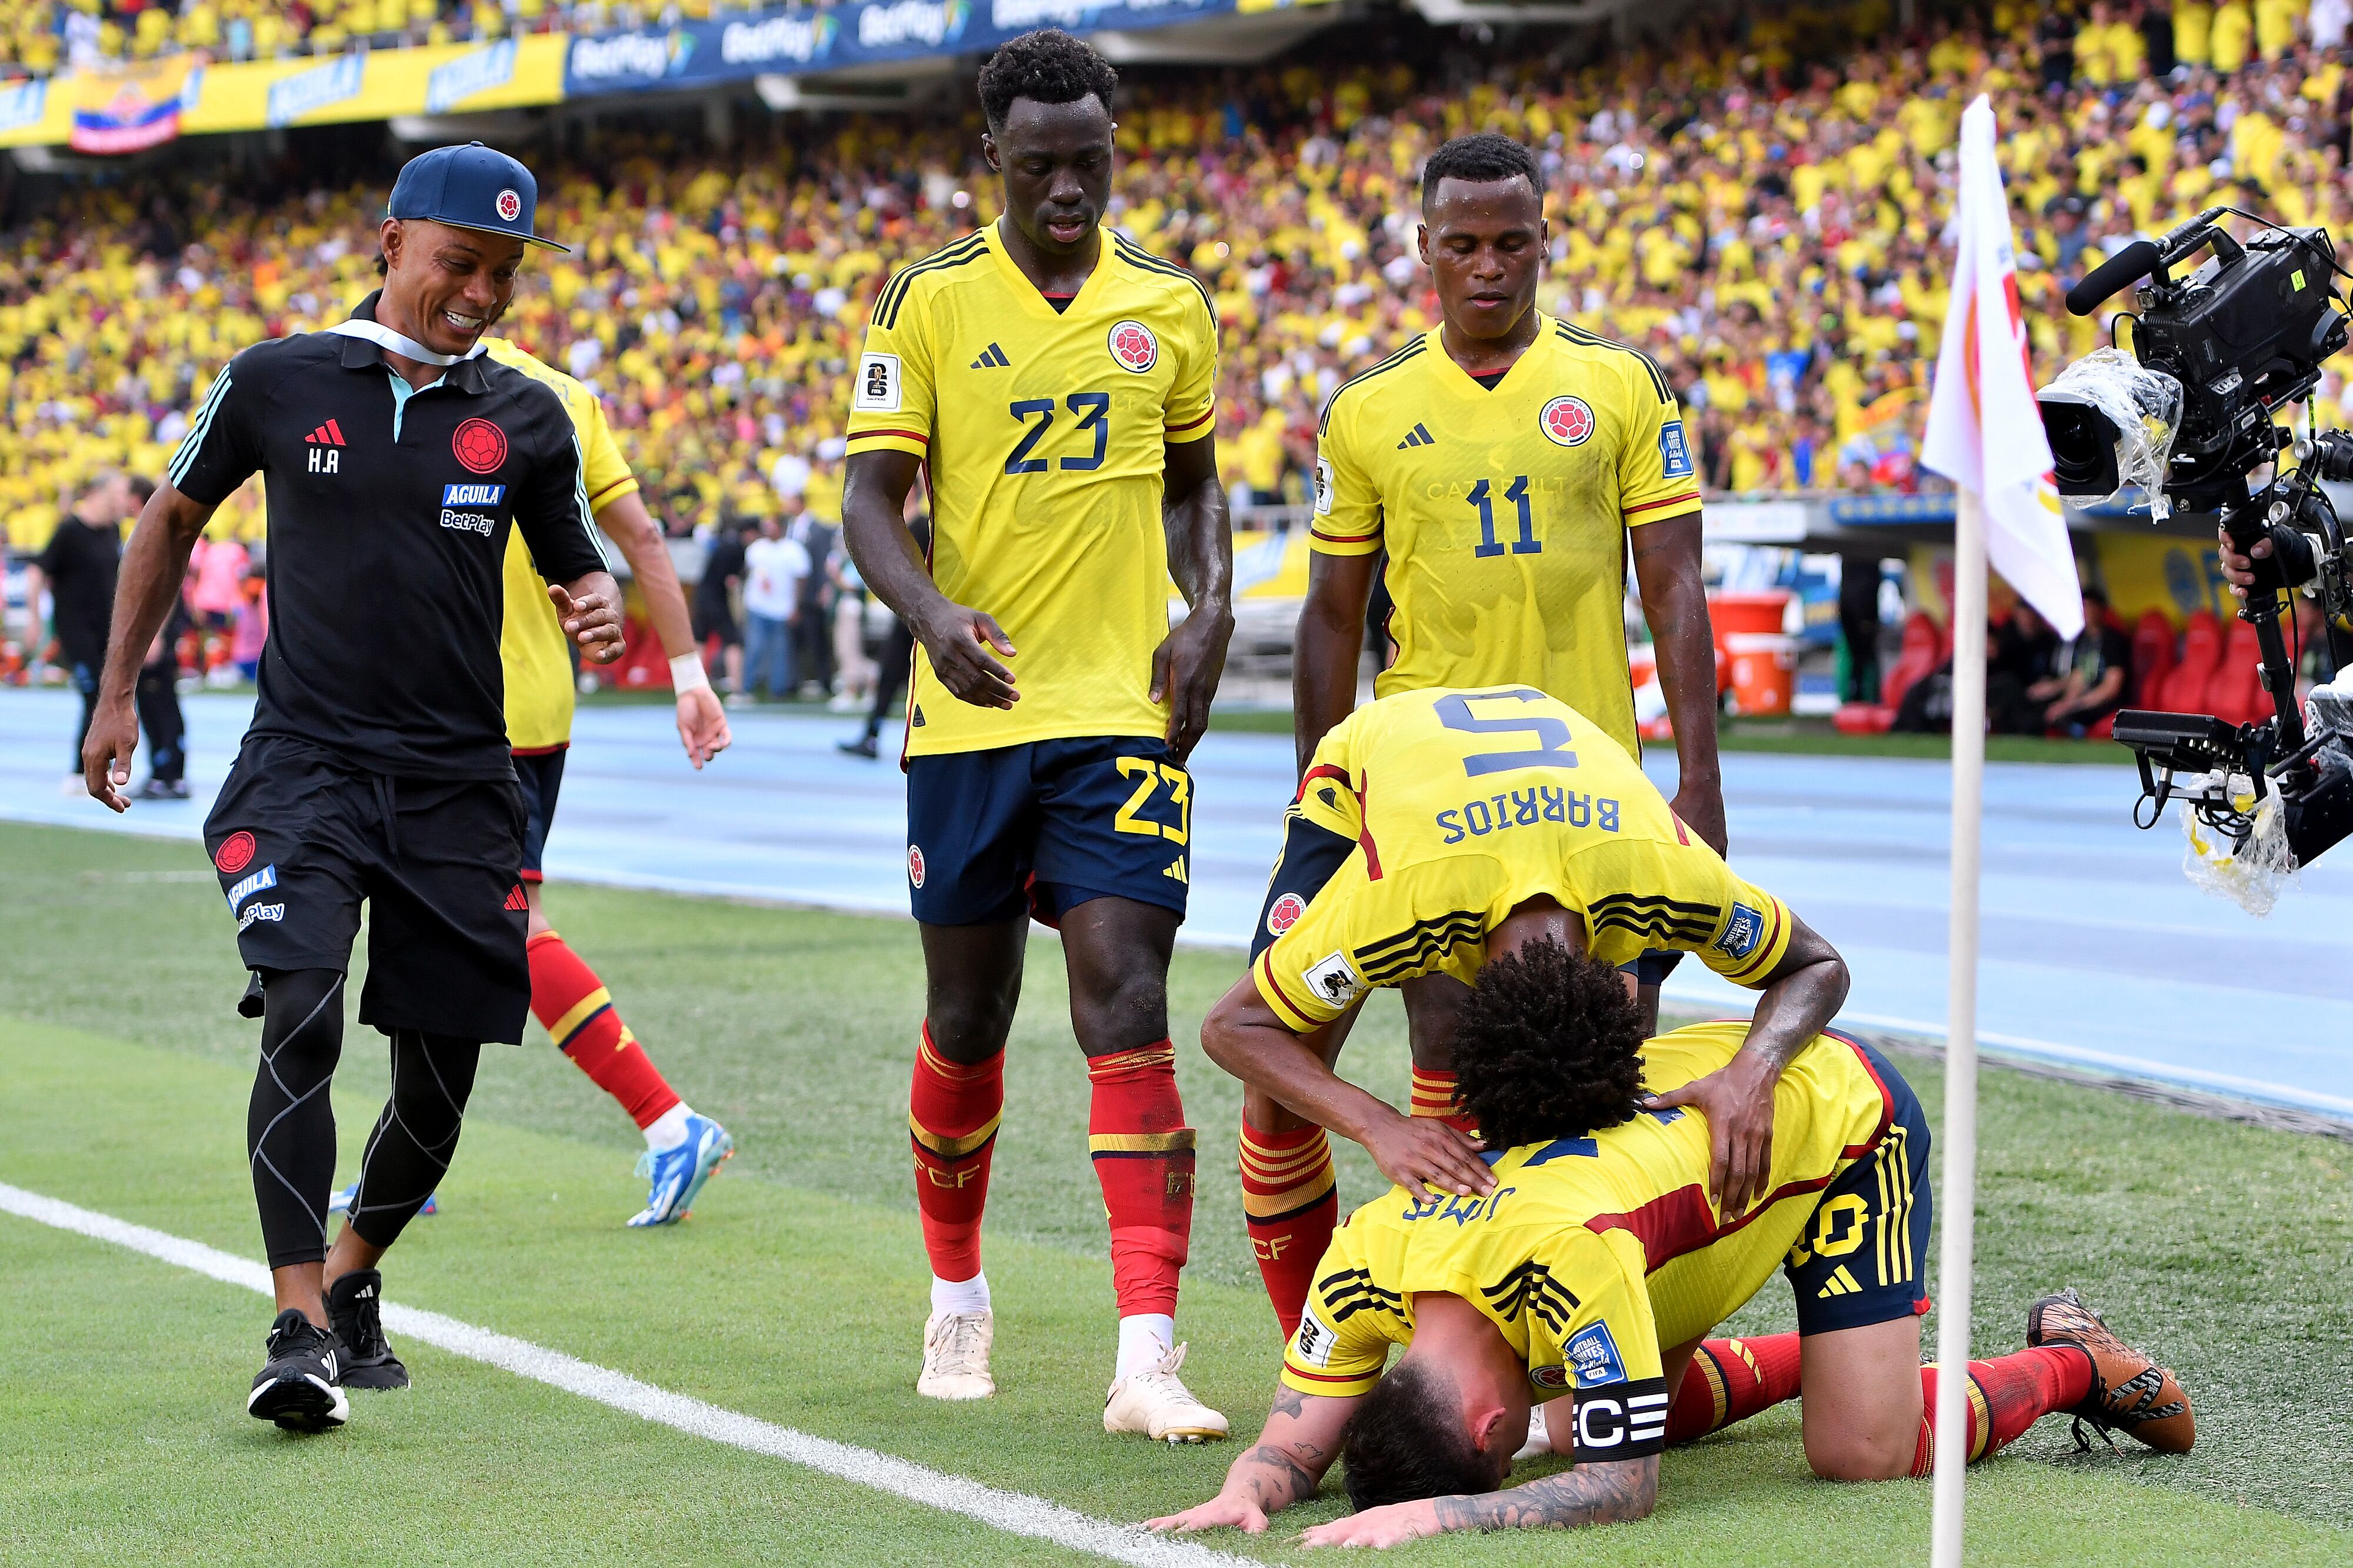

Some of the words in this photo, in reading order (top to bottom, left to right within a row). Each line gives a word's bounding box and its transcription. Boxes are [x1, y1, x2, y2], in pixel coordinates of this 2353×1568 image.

[1005, 392, 1110, 475] 23
[445, 485, 500, 505] AGUILA
[1466, 475, 1542, 558] 11
[440, 509, 495, 536] BetPlay
[1433, 689, 1579, 777] 5
[1115, 756, 1190, 846] 23
[1435, 786, 1619, 845] BARRIOS
[1572, 1335, 1601, 1356] OOTBALL
[1588, 1353, 1611, 1369] World
[1579, 1399, 1624, 1447] C
